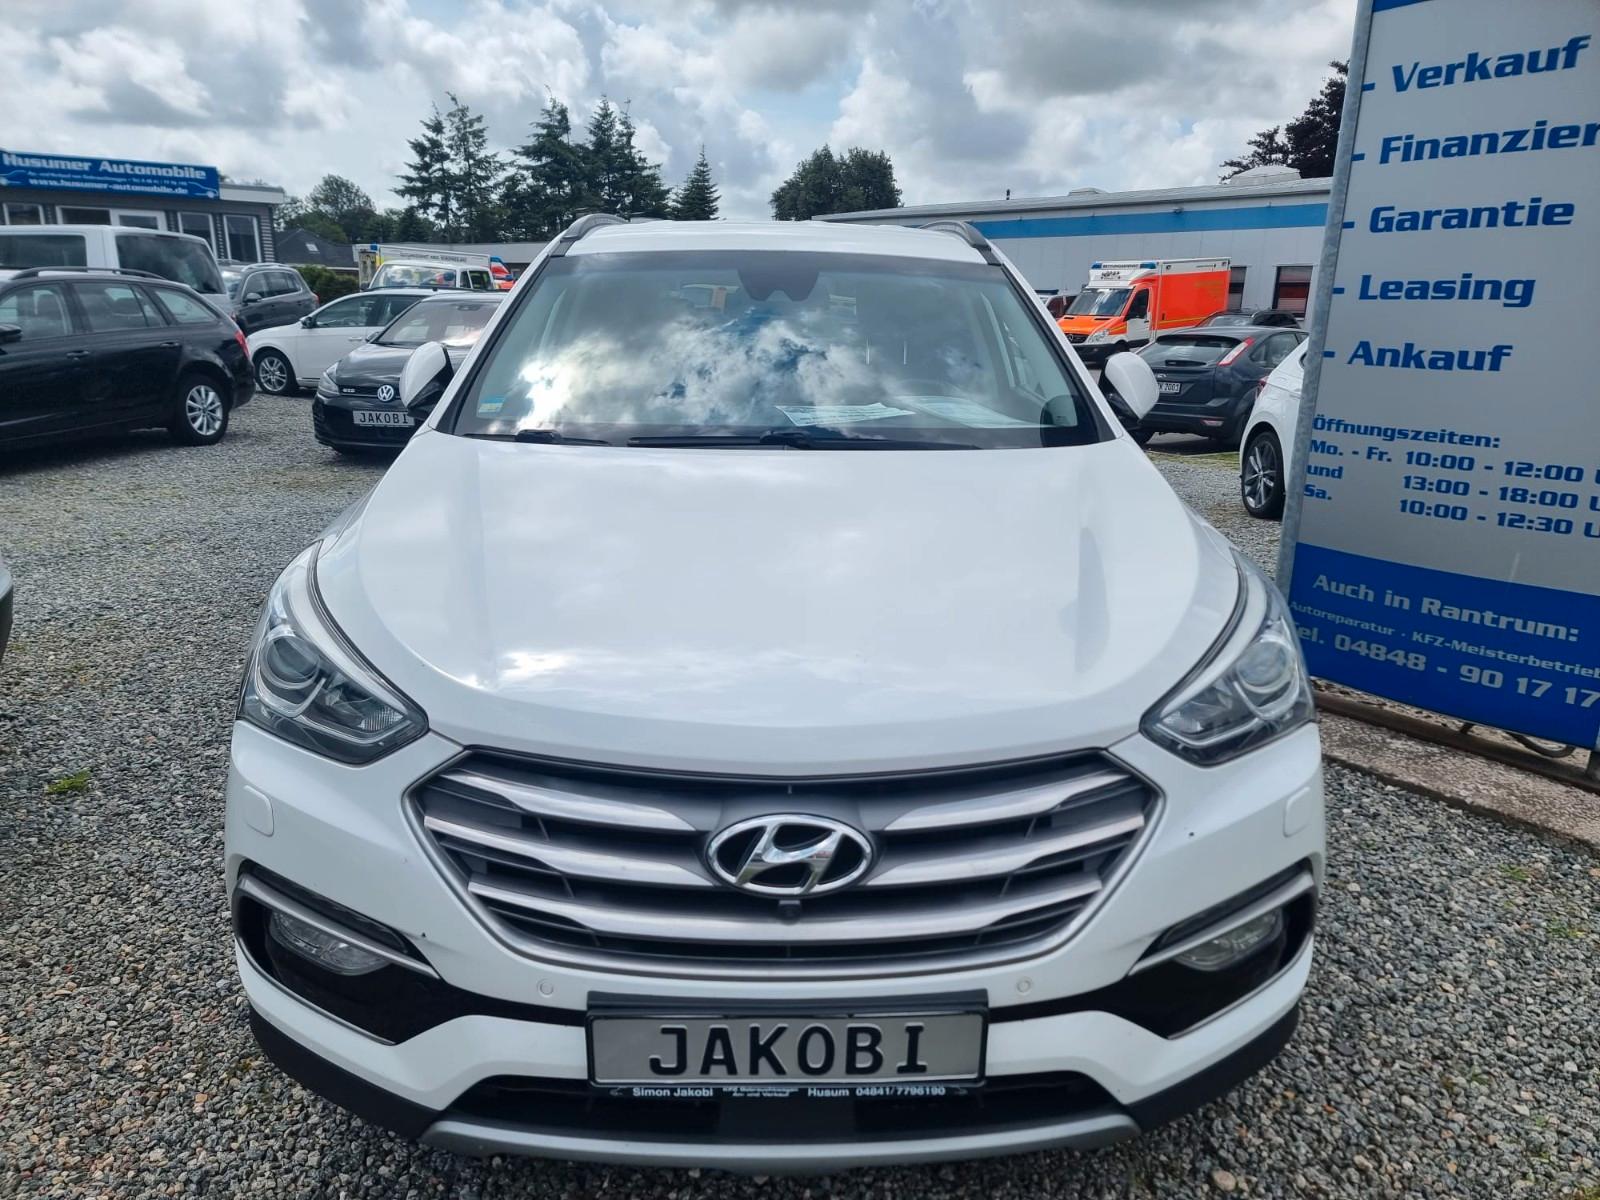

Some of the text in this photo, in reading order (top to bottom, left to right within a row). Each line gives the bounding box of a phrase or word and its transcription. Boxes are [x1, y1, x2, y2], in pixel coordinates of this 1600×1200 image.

[1392, 34, 1592, 93] Verkauf
[1379, 120, 1600, 165] Finanzier
[2, 153, 92, 172] Husumer
[99, 160, 207, 180] Automobile
[28, 178, 188, 195] www.husumer-automobile.de
[1369, 196, 1575, 233] Garantie
[1358, 272, 1536, 308] Leasing
[1347, 340, 1513, 372] Ankauf
[360, 412, 409, 424] JAKOBI
[1313, 413, 1500, 448] Öffnungszeiten:
[1310, 440, 1343, 456] Mo.
[1366, 446, 1392, 463] Fr.
[1405, 450, 1475, 472] 10:00
[1504, 461, 1584, 482] 12:00
[1307, 465, 1343, 479] und
[1403, 475, 1470, 496] 13:00
[1499, 486, 1579, 509] 18:00
[1303, 484, 1332, 500] Sa.
[1399, 499, 1467, 521] 10:00
[1497, 512, 1573, 535] 12:30
[1290, 601, 1395, 636] Autoreparatur
[1313, 574, 1579, 642] Auch in Rantrum:
[1296, 622, 1325, 645] el.
[1334, 634, 1427, 672] 04848
[1460, 664, 1503, 689] 90
[1516, 677, 1553, 698] 17
[1565, 687, 1600, 708] 17
[649, 1022, 928, 1076] JAKOBI
[633, 1087, 713, 1097] Simon Jakobi
[808, 1086, 946, 1097] Husum 04841/7796190
